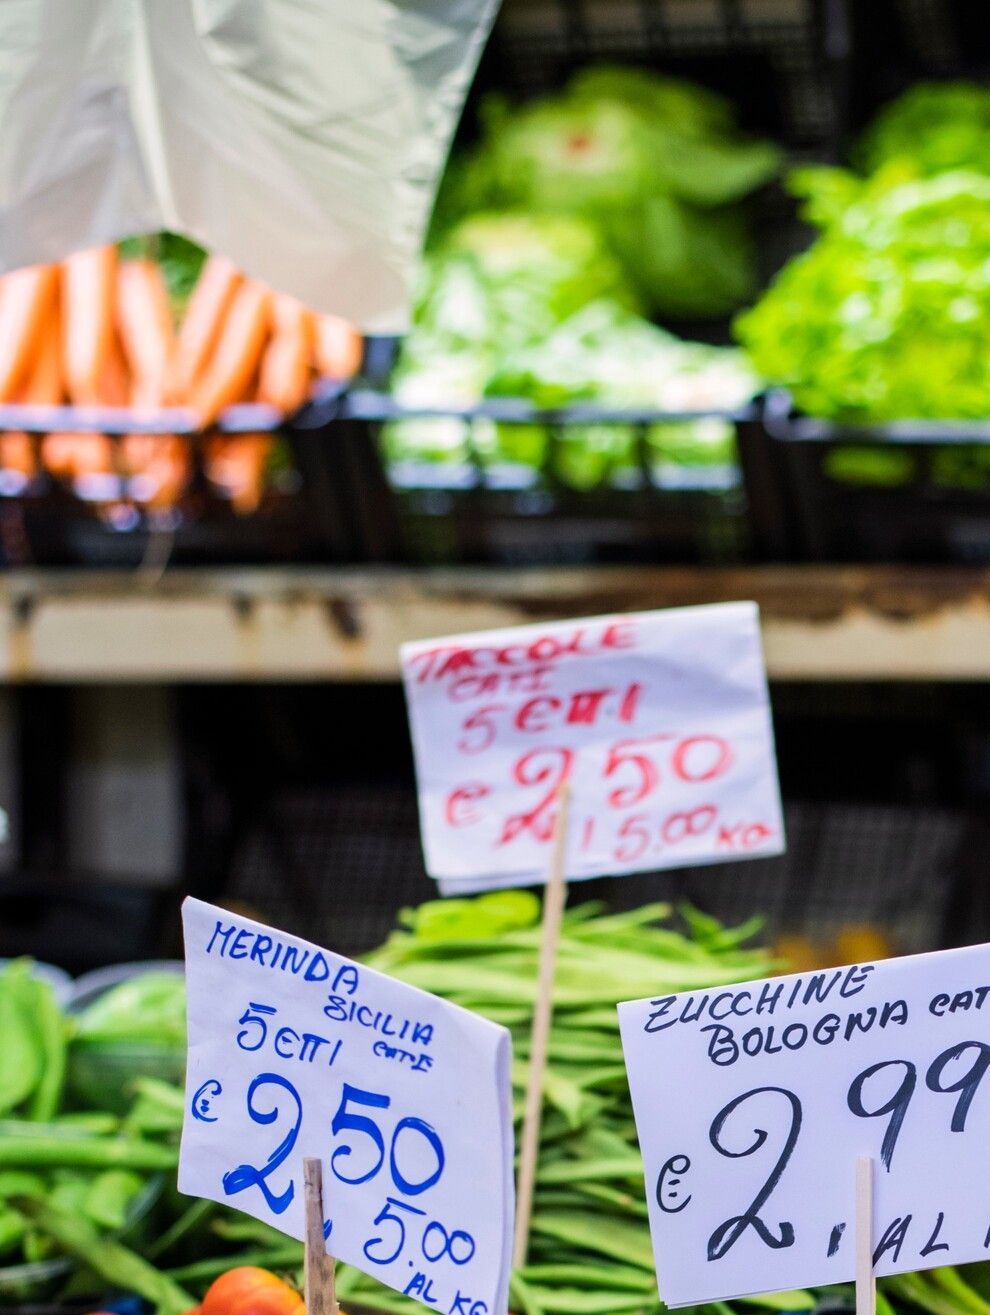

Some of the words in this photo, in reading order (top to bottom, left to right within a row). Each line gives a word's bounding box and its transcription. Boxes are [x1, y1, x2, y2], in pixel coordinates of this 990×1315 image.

[206, 920, 359, 995] MERINDA
[323, 994, 435, 1046] SICILIA
[643, 964, 876, 1033] ZUCCHINE
[699, 998, 909, 1067] BOLOGNA
[872, 1212, 950, 1269] AL
[403, 1270, 438, 1303] AL
